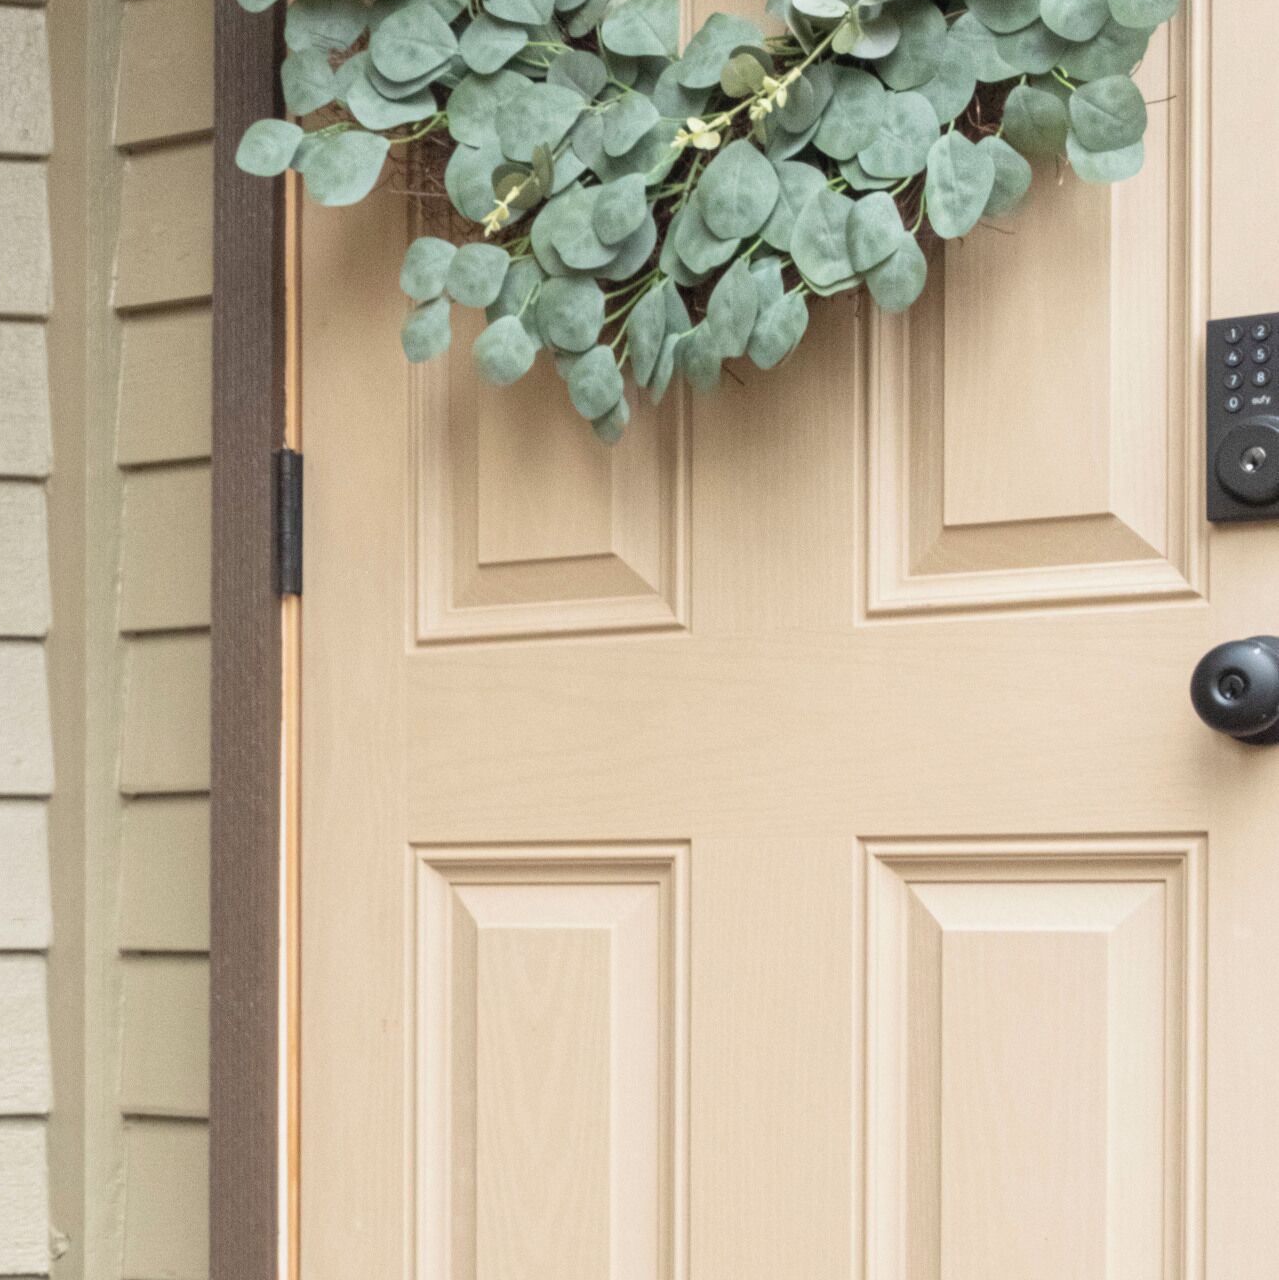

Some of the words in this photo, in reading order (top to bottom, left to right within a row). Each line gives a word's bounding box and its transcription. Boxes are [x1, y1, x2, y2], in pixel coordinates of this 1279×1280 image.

[1257, 325, 1265, 337] 2
[1228, 351, 1238, 363] 4
[1256, 348, 1265, 361] 5
[1230, 374, 1238, 386] 7
[1256, 371, 1265, 384] 8
[1229, 396, 1238, 409] 0
